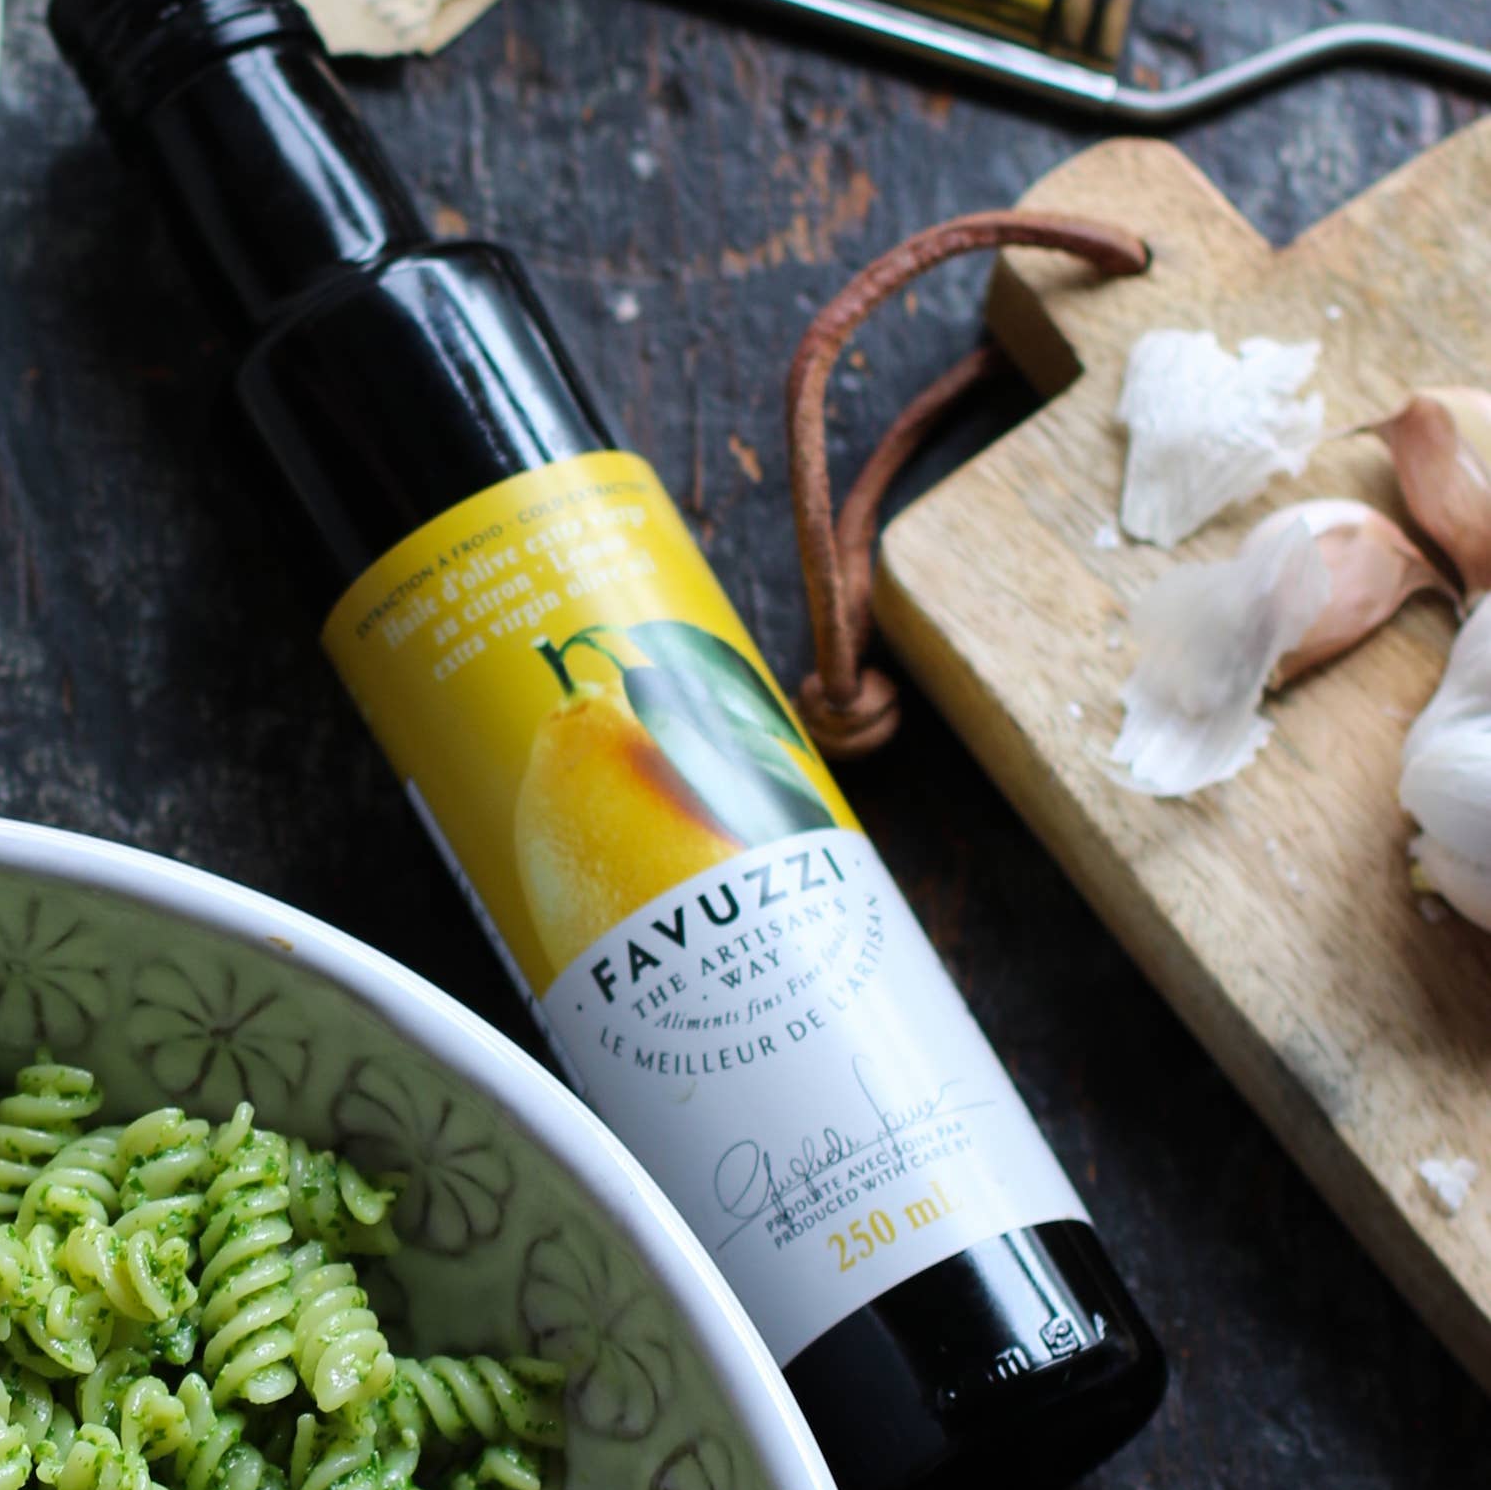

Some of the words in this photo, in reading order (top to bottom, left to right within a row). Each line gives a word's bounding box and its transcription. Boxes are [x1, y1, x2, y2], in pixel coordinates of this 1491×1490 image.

[452, 522, 504, 562] FROID
[517, 494, 564, 527] COLD
[381, 593, 439, 650] Huile
[441, 544, 519, 603] d'olive
[524, 518, 584, 555] extra
[586, 503, 647, 532] vierg
[433, 618, 461, 647] au
[463, 572, 533, 624] citron
[432, 634, 489, 683] extra
[489, 585, 562, 639] virgin
[590, 846, 845, 1004] FAVUZZI
[631, 971, 688, 1021] THE
[698, 895, 847, 978] ARTISAN'S
[719, 947, 782, 991] WAY
[599, 1025, 626, 1058] LE
[634, 1033, 778, 1076] MEILLEUR
[785, 1007, 826, 1043] DE
[826, 893, 885, 1012] L'ARTISAN
[653, 1006, 741, 1031] Aliments
[745, 991, 784, 1025] fins
[786, 963, 823, 997] Fine
[764, 1176, 844, 1235] PRODUITE
[847, 1149, 891, 1182] AVEC
[773, 1188, 860, 1251] PRODUCED
[860, 1161, 908, 1193] WITH
[826, 1207, 897, 1274] 250
